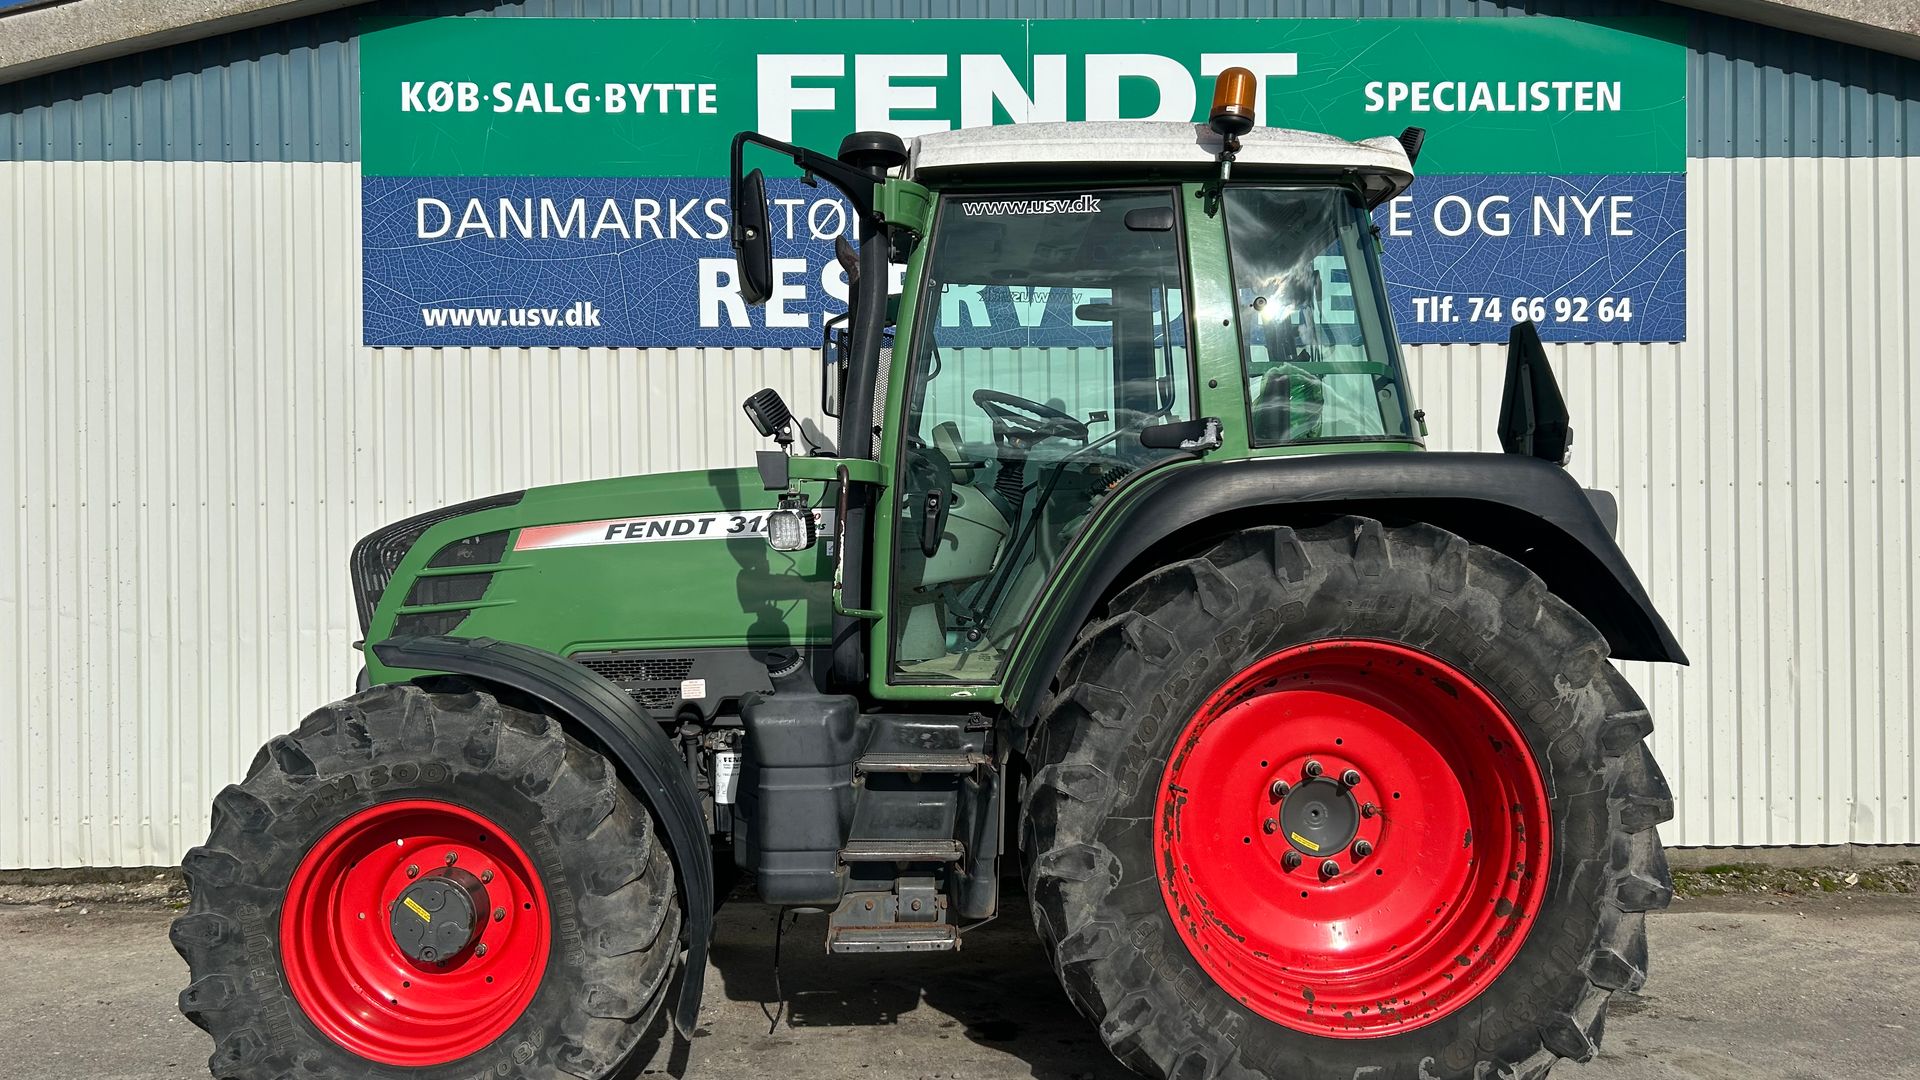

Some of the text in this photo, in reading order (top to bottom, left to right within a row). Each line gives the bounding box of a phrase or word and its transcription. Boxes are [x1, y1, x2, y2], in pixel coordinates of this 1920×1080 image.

[757, 53, 1298, 143] FENDT
[1364, 81, 1621, 112] SPECIALISTEN
[417, 197, 729, 239] DANMARKS
[1433, 195, 1510, 236] OG
[1533, 196, 1634, 236] NYE
[962, 194, 1101, 216] www.usv.dk
[421, 302, 601, 327] www.usv.dk
[1412, 296, 1633, 323] Tlf. 74 66 92 64
[604, 517, 717, 541] FENDT
